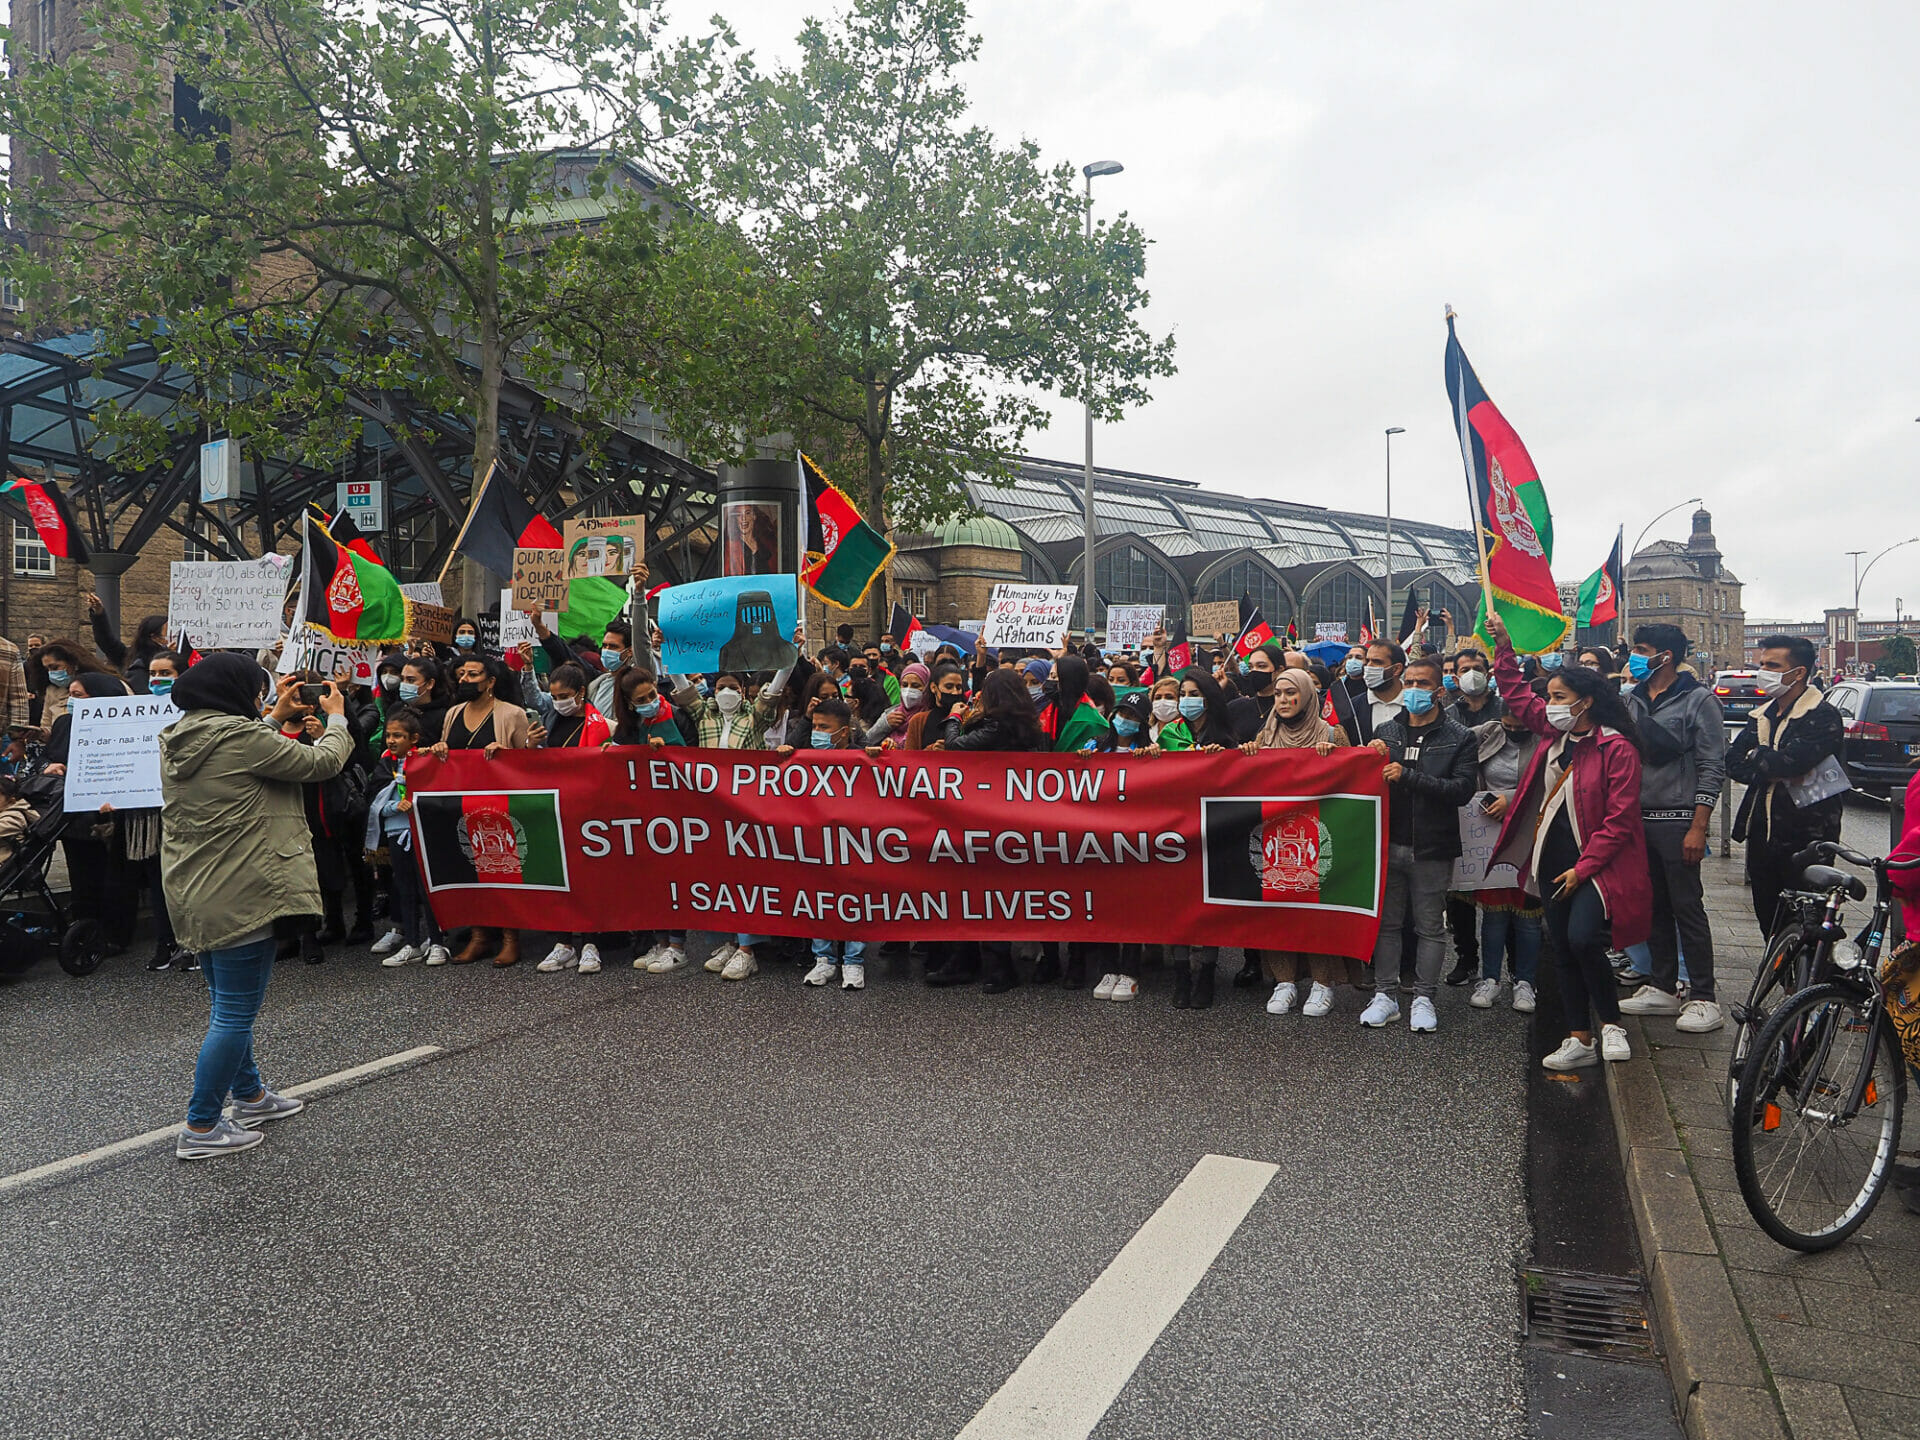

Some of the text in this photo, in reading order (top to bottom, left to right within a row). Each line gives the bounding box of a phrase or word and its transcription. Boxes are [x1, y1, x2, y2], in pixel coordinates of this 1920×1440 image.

[204, 444, 225, 495] U
[352, 485, 366, 493] U2
[352, 497, 366, 505] U4
[576, 518, 636, 530] Afghanistan
[517, 551, 545, 566] OUR
[528, 570, 553, 584] OUR
[172, 581, 202, 600] Krieg
[516, 584, 568, 600] IDENTITY
[671, 588, 704, 605] Stand
[997, 585, 1075, 603] Humanity has
[1557, 586, 1577, 596] IRLS
[171, 599, 189, 612] bin
[215, 598, 231, 612] 50
[993, 600, 1016, 614] NO
[691, 604, 729, 625] Afghan
[996, 613, 1022, 626] Stop
[413, 617, 452, 634] AKISTAN
[503, 626, 539, 642] AFGHAN
[992, 624, 1056, 644] Afghans
[665, 635, 714, 656] Women
[81, 703, 182, 720] PADARNA
[649, 760, 720, 794] END
[731, 763, 862, 798] PROXY
[872, 766, 964, 801] WAR
[1005, 768, 1105, 802] NOW
[580, 816, 1188, 866] STOP KILLING AFGHANS
[690, 882, 783, 916] SAVE
[792, 889, 949, 923] AFGHAN
[960, 889, 1072, 921] LIVES
